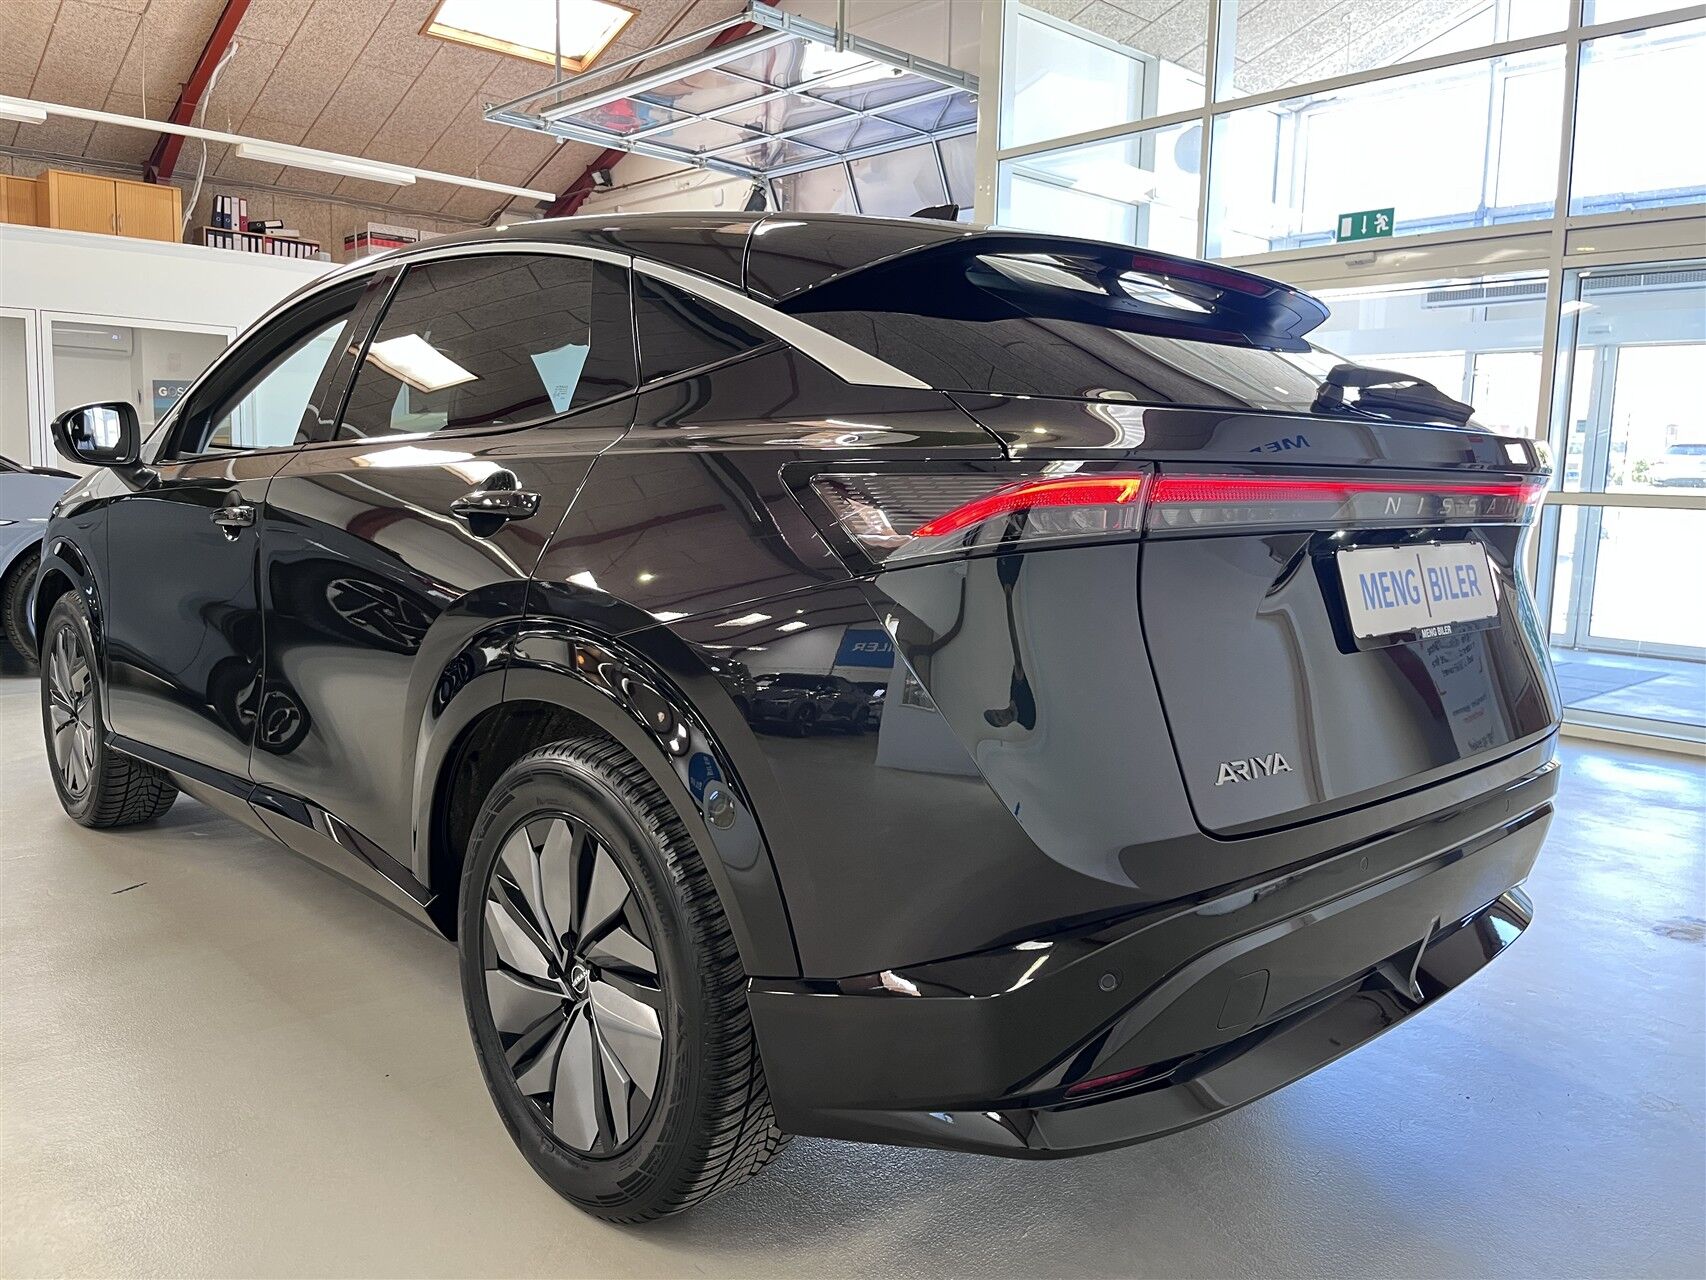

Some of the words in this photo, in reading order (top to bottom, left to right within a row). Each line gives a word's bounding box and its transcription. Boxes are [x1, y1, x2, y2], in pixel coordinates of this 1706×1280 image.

[158, 386, 188, 397] GOS
[1359, 568, 1421, 611] MENG
[1427, 564, 1482, 602] BILER
[1421, 627, 1437, 638] MENG
[1436, 625, 1452, 636] BILER
[1214, 752, 1293, 786] ARIYA
